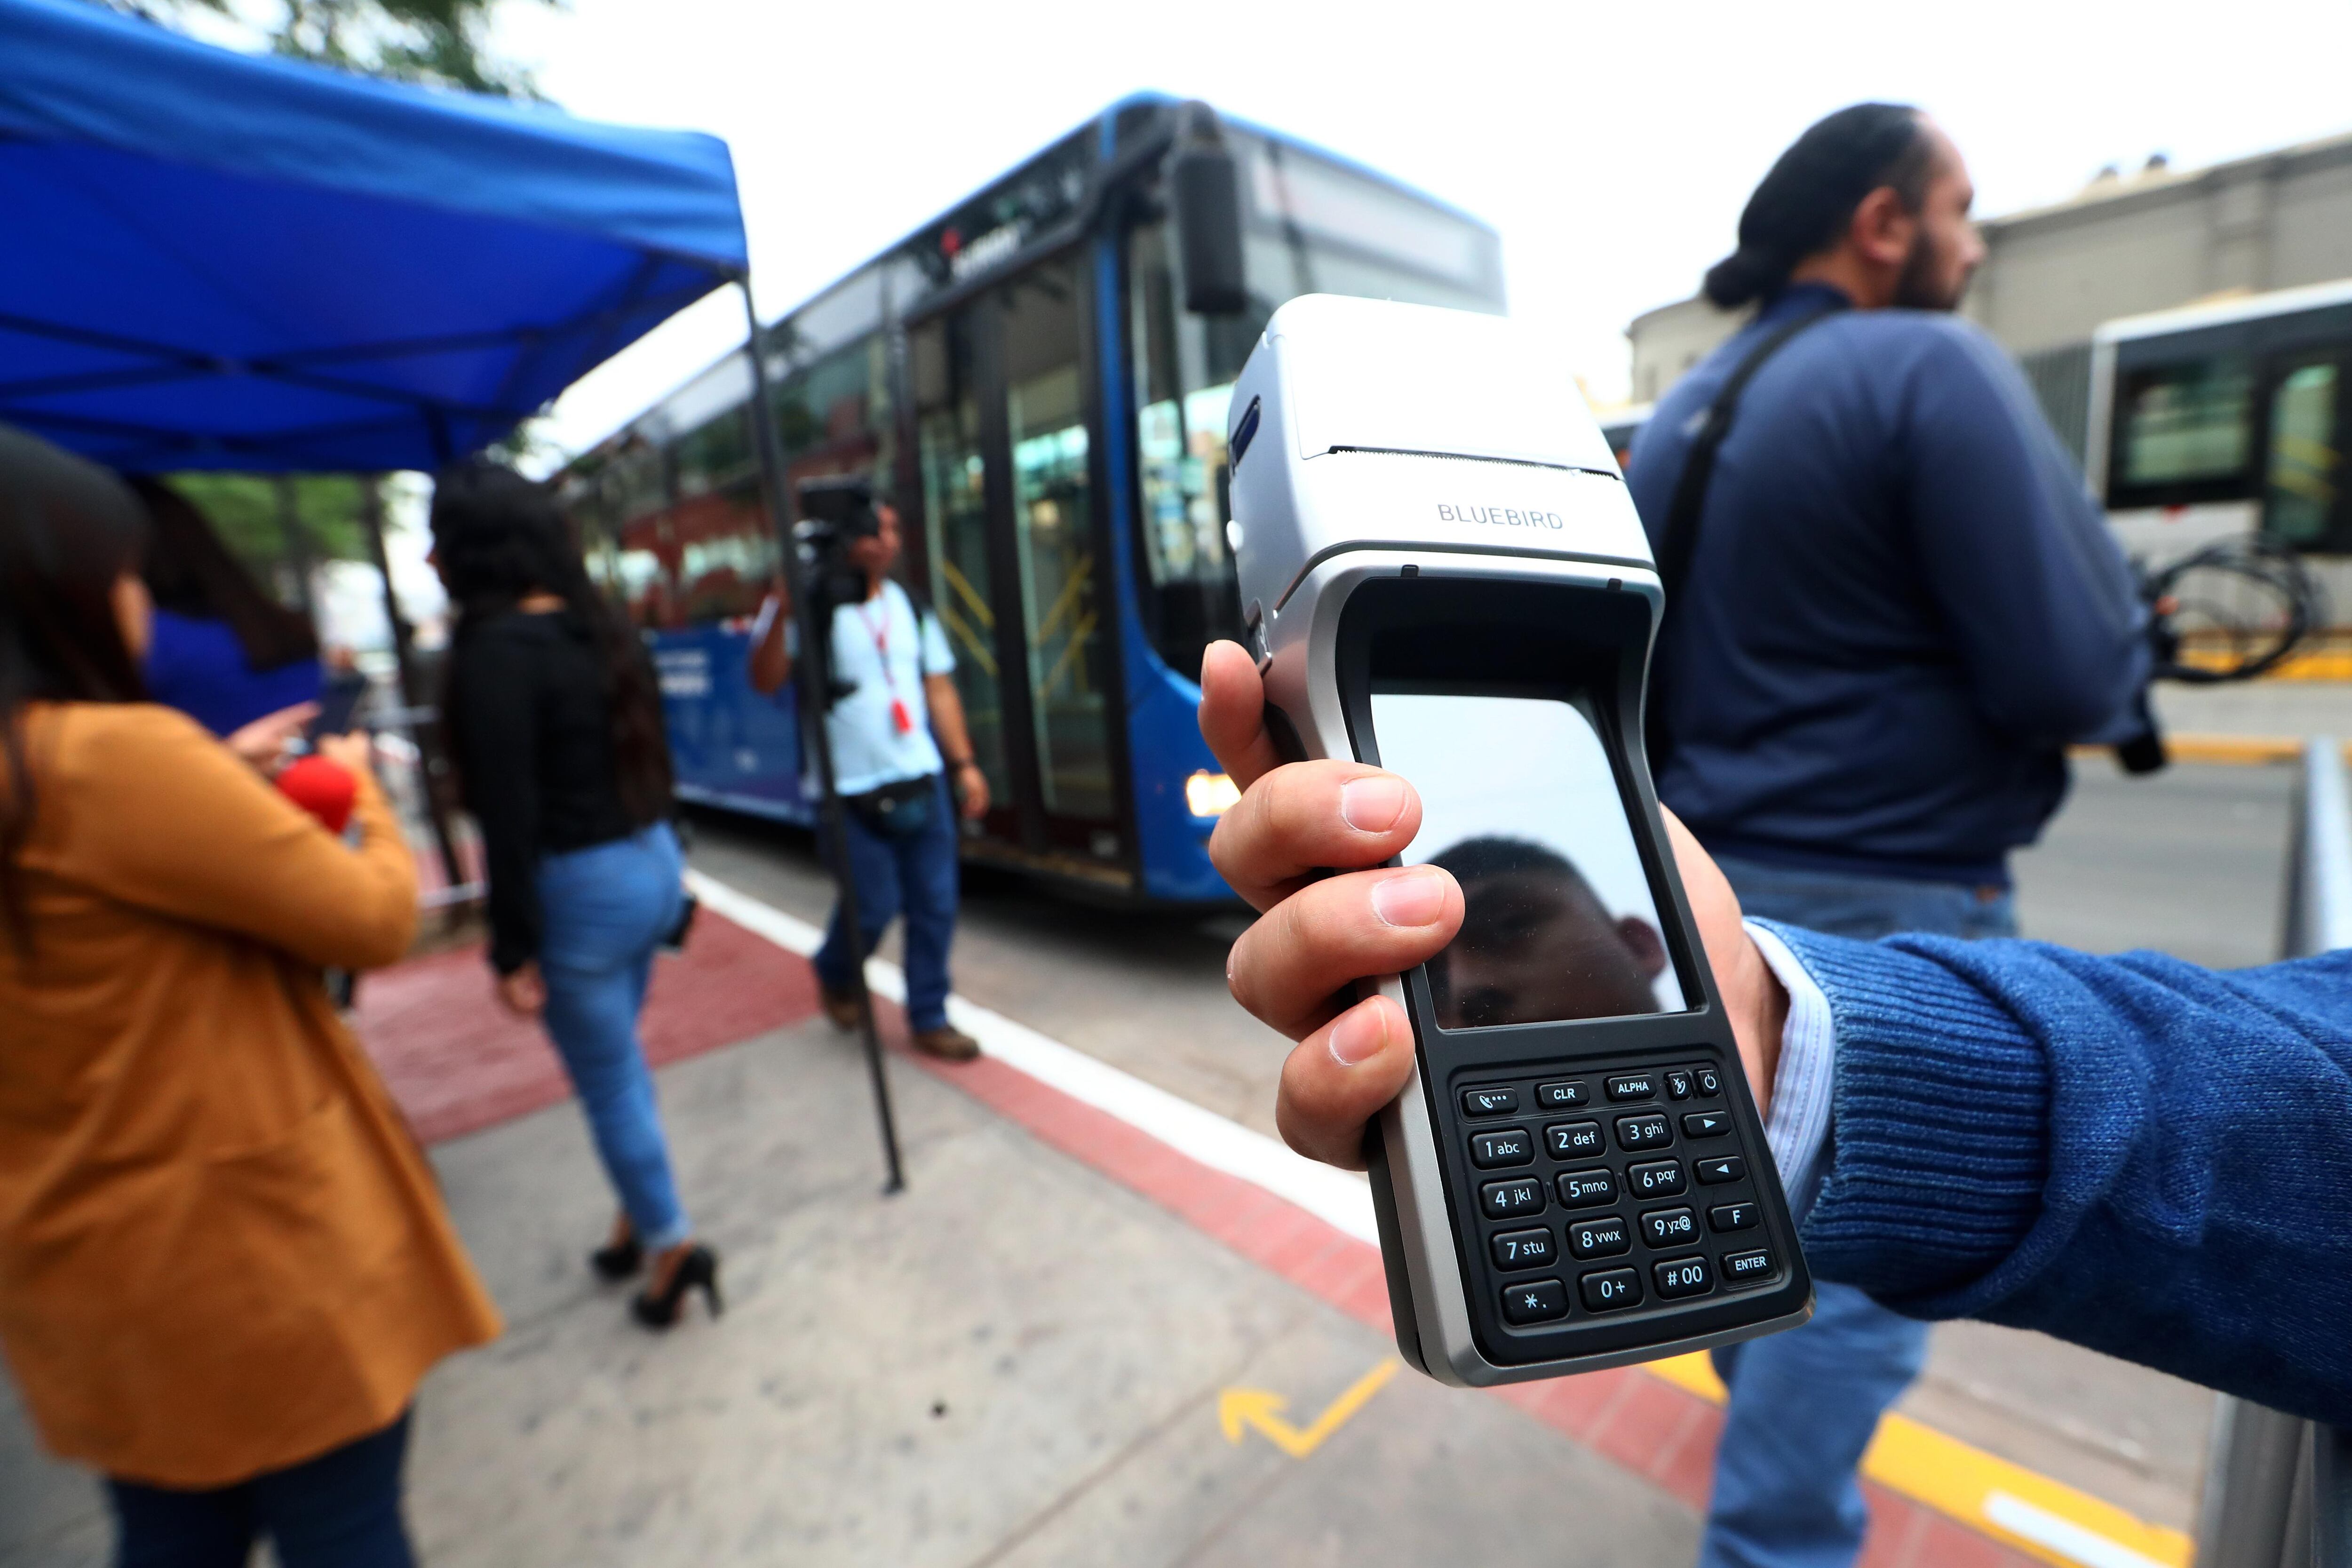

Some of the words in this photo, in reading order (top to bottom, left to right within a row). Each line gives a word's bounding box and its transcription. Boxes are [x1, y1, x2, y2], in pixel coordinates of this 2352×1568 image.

[1438, 504, 1563, 529] BLUEBIRD
[1553, 1088, 1576, 1100] CLR
[1618, 1082, 1649, 1093] ALPHA
[1557, 1132, 1569, 1148] 2
[1573, 1131, 1595, 1146] def
[1629, 1124, 1640, 1139] 3
[1645, 1123, 1664, 1138] ghi
[1486, 1141, 1492, 1157] 1
[1497, 1141, 1520, 1155] abc
[1643, 1172, 1653, 1187] 6
[1656, 1170, 1676, 1184] pqr
[1495, 1191, 1507, 1207] 4
[1514, 1187, 1531, 1205] jkl
[1732, 1210, 1740, 1224] F
[1654, 1219, 1665, 1236] 9
[1667, 1216, 1691, 1234] yz@
[1582, 1231, 1593, 1248] 8
[1595, 1230, 1621, 1243] vwx
[1507, 1242, 1517, 1259] 7
[1523, 1241, 1545, 1255] stu
[1735, 1256, 1766, 1271] ENTER
